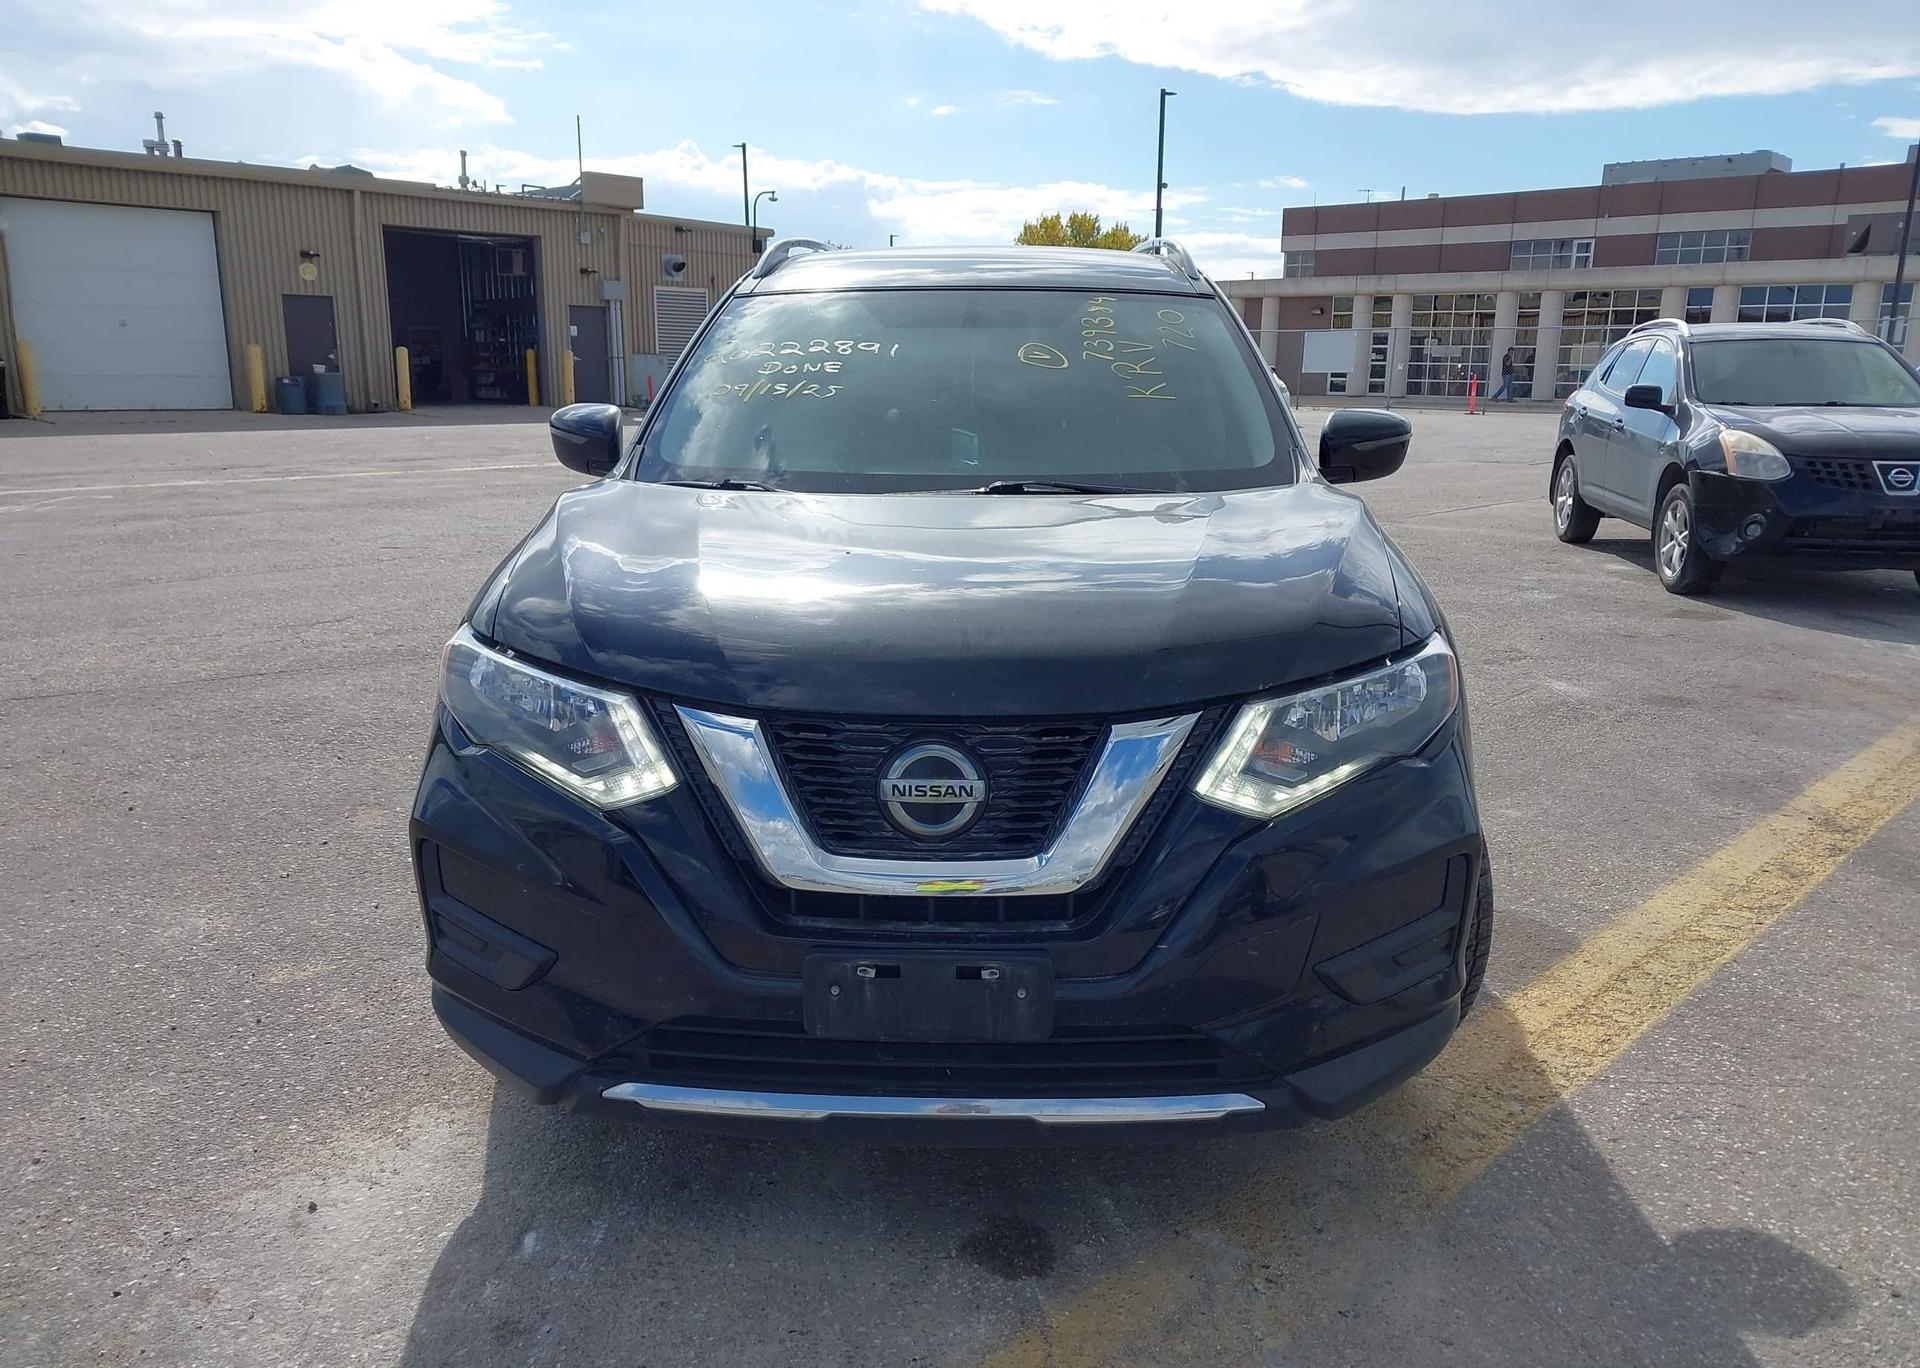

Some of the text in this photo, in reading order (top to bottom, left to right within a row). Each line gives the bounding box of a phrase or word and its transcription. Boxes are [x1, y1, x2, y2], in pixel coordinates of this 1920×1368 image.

[1156, 309, 1197, 351] 720
[757, 361, 843, 375] DONE
[1110, 340, 1177, 400] KRV
[712, 379, 844, 403] 09/15/25
[891, 784, 974, 798] NISSAN
